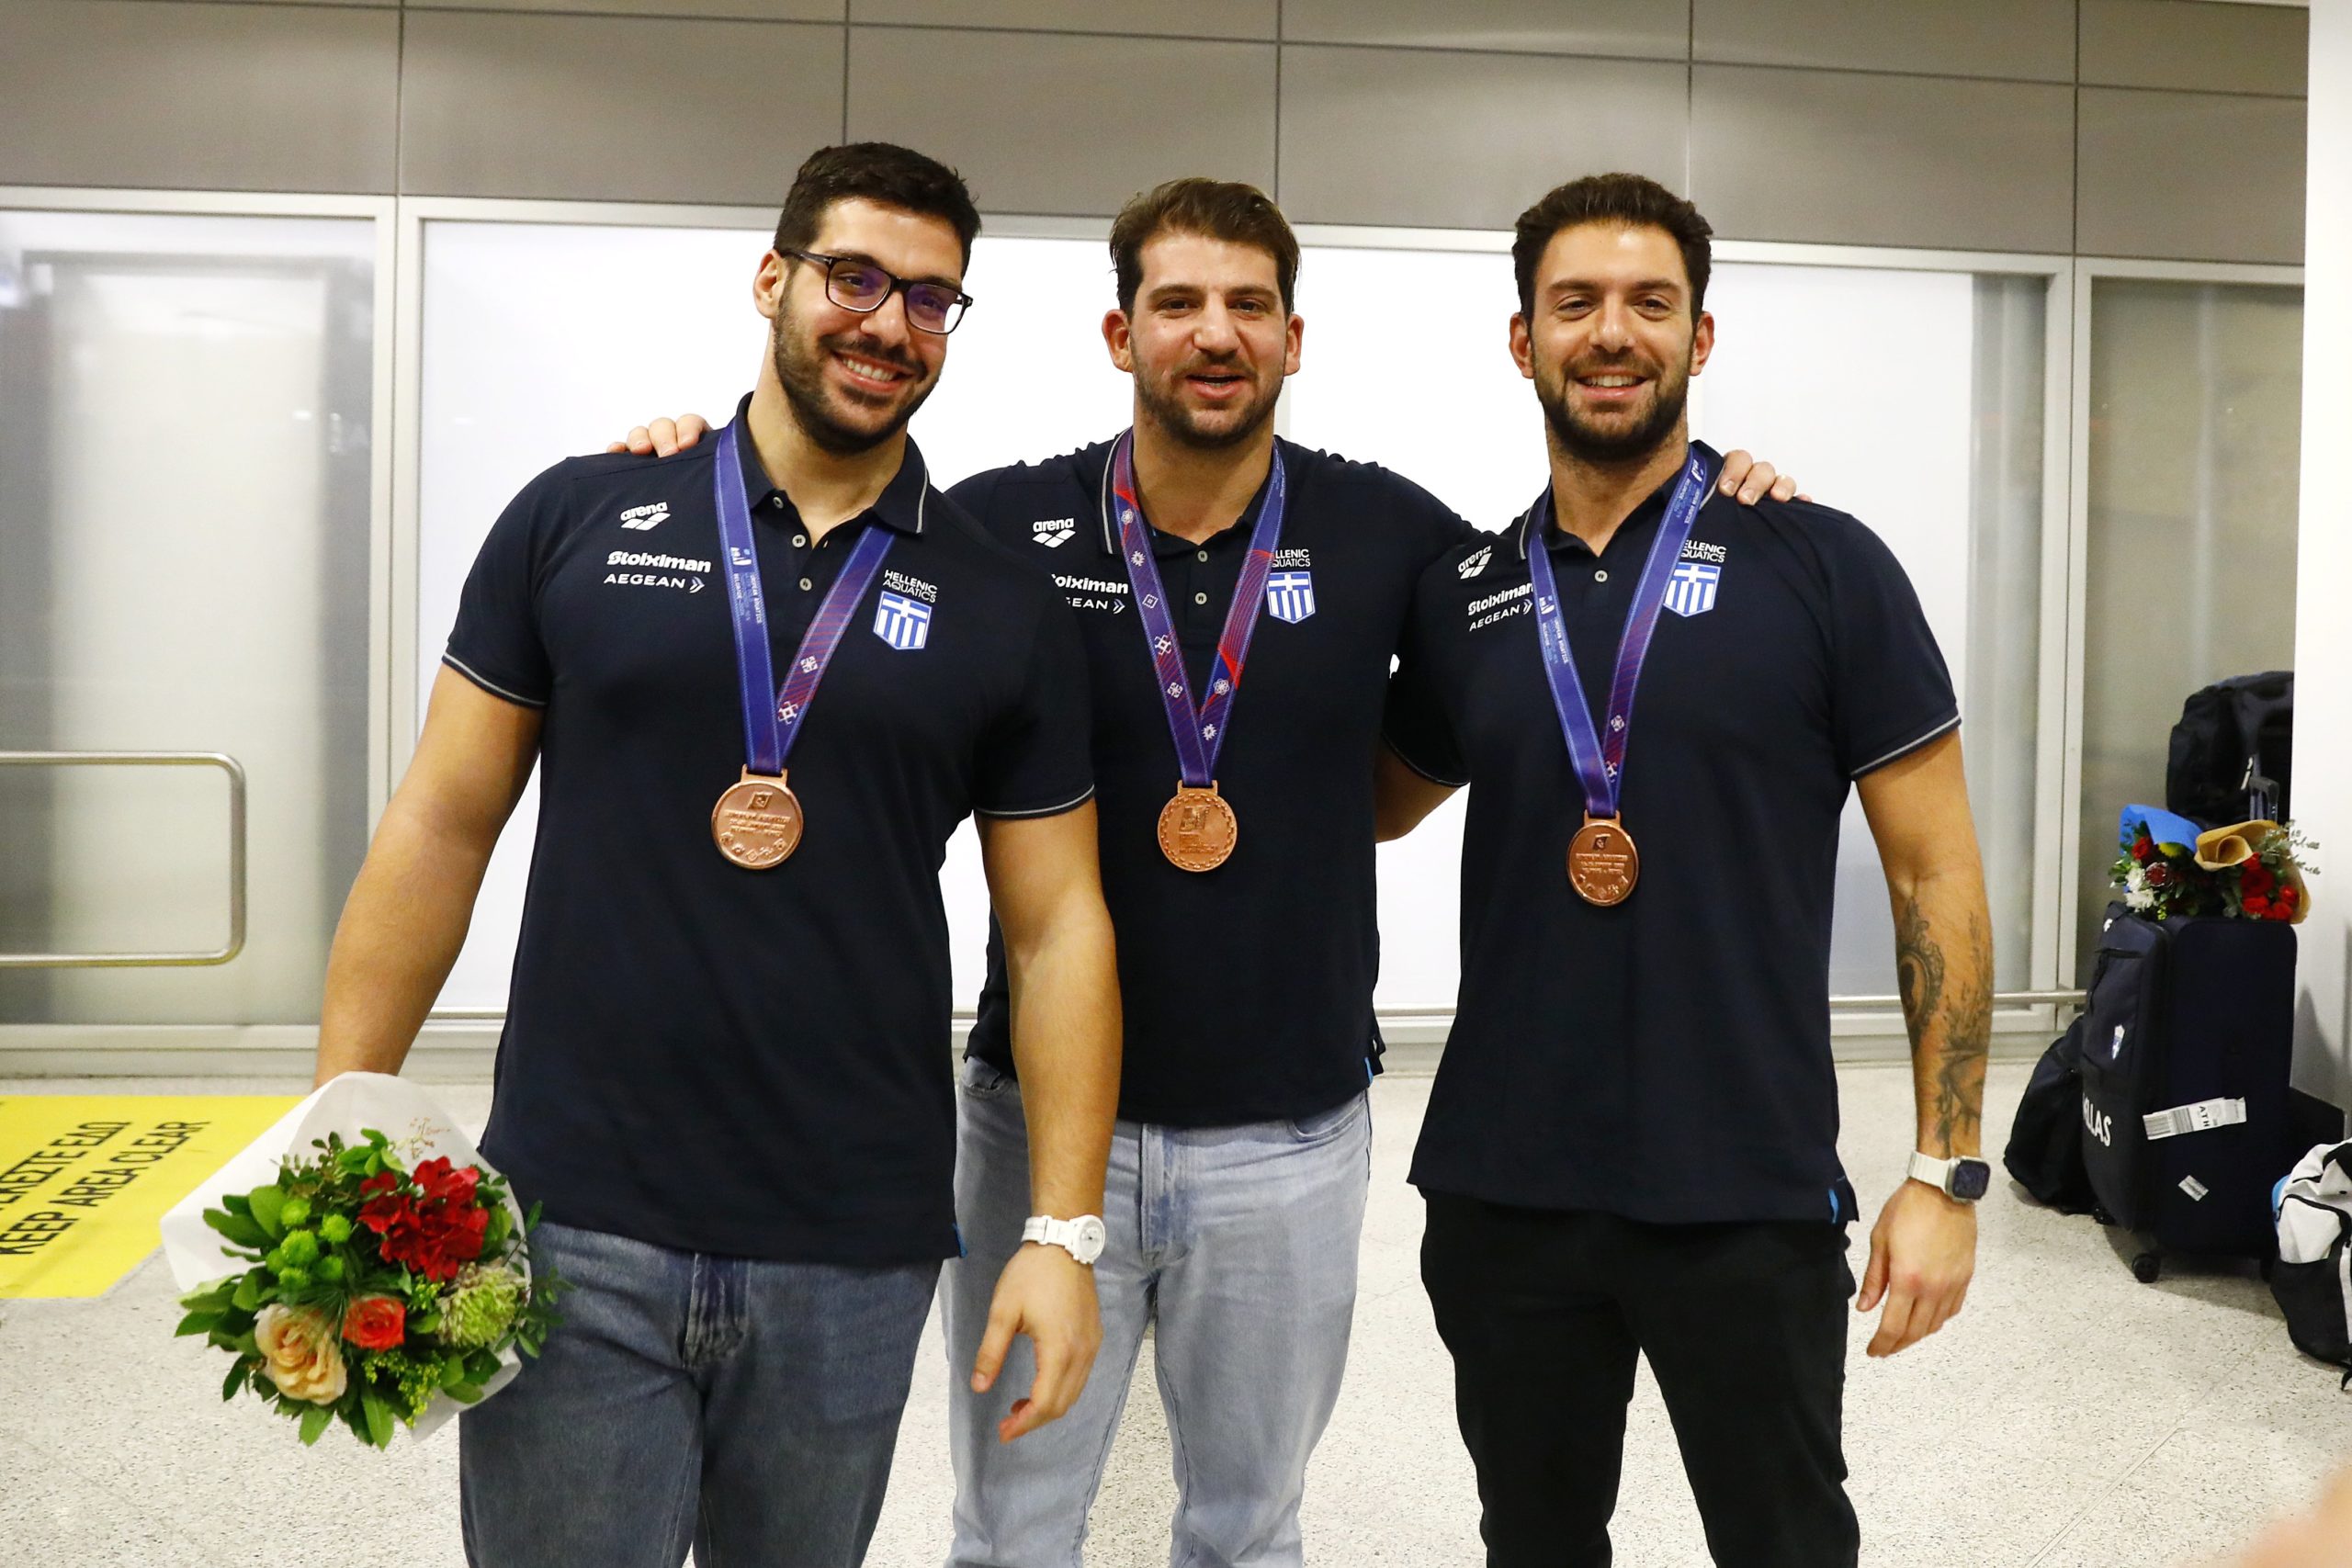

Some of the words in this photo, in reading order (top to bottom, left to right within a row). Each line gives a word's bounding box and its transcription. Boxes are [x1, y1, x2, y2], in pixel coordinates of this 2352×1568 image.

[620, 502, 668, 521] arena
[1033, 517, 1075, 533] arena
[606, 550, 712, 573] Stoiximan
[1272, 558, 1311, 568] QUATICS
[1275, 548, 1309, 559] LLENIC
[1458, 545, 1492, 572] arena
[1680, 548, 1725, 563] QUATICS
[603, 573, 685, 589] AEGEAN
[882, 579, 937, 604] AQUATICS
[884, 569, 938, 594] HELLENIC
[1051, 573, 1129, 594] oiximan
[1469, 604, 1521, 632] AEGEAN
[2199, 1105, 2211, 1127] ATH
[0, 1211, 80, 1255] KEEP
[48, 1167, 149, 1207] AREA
[109, 1122, 211, 1163] CLEAR
